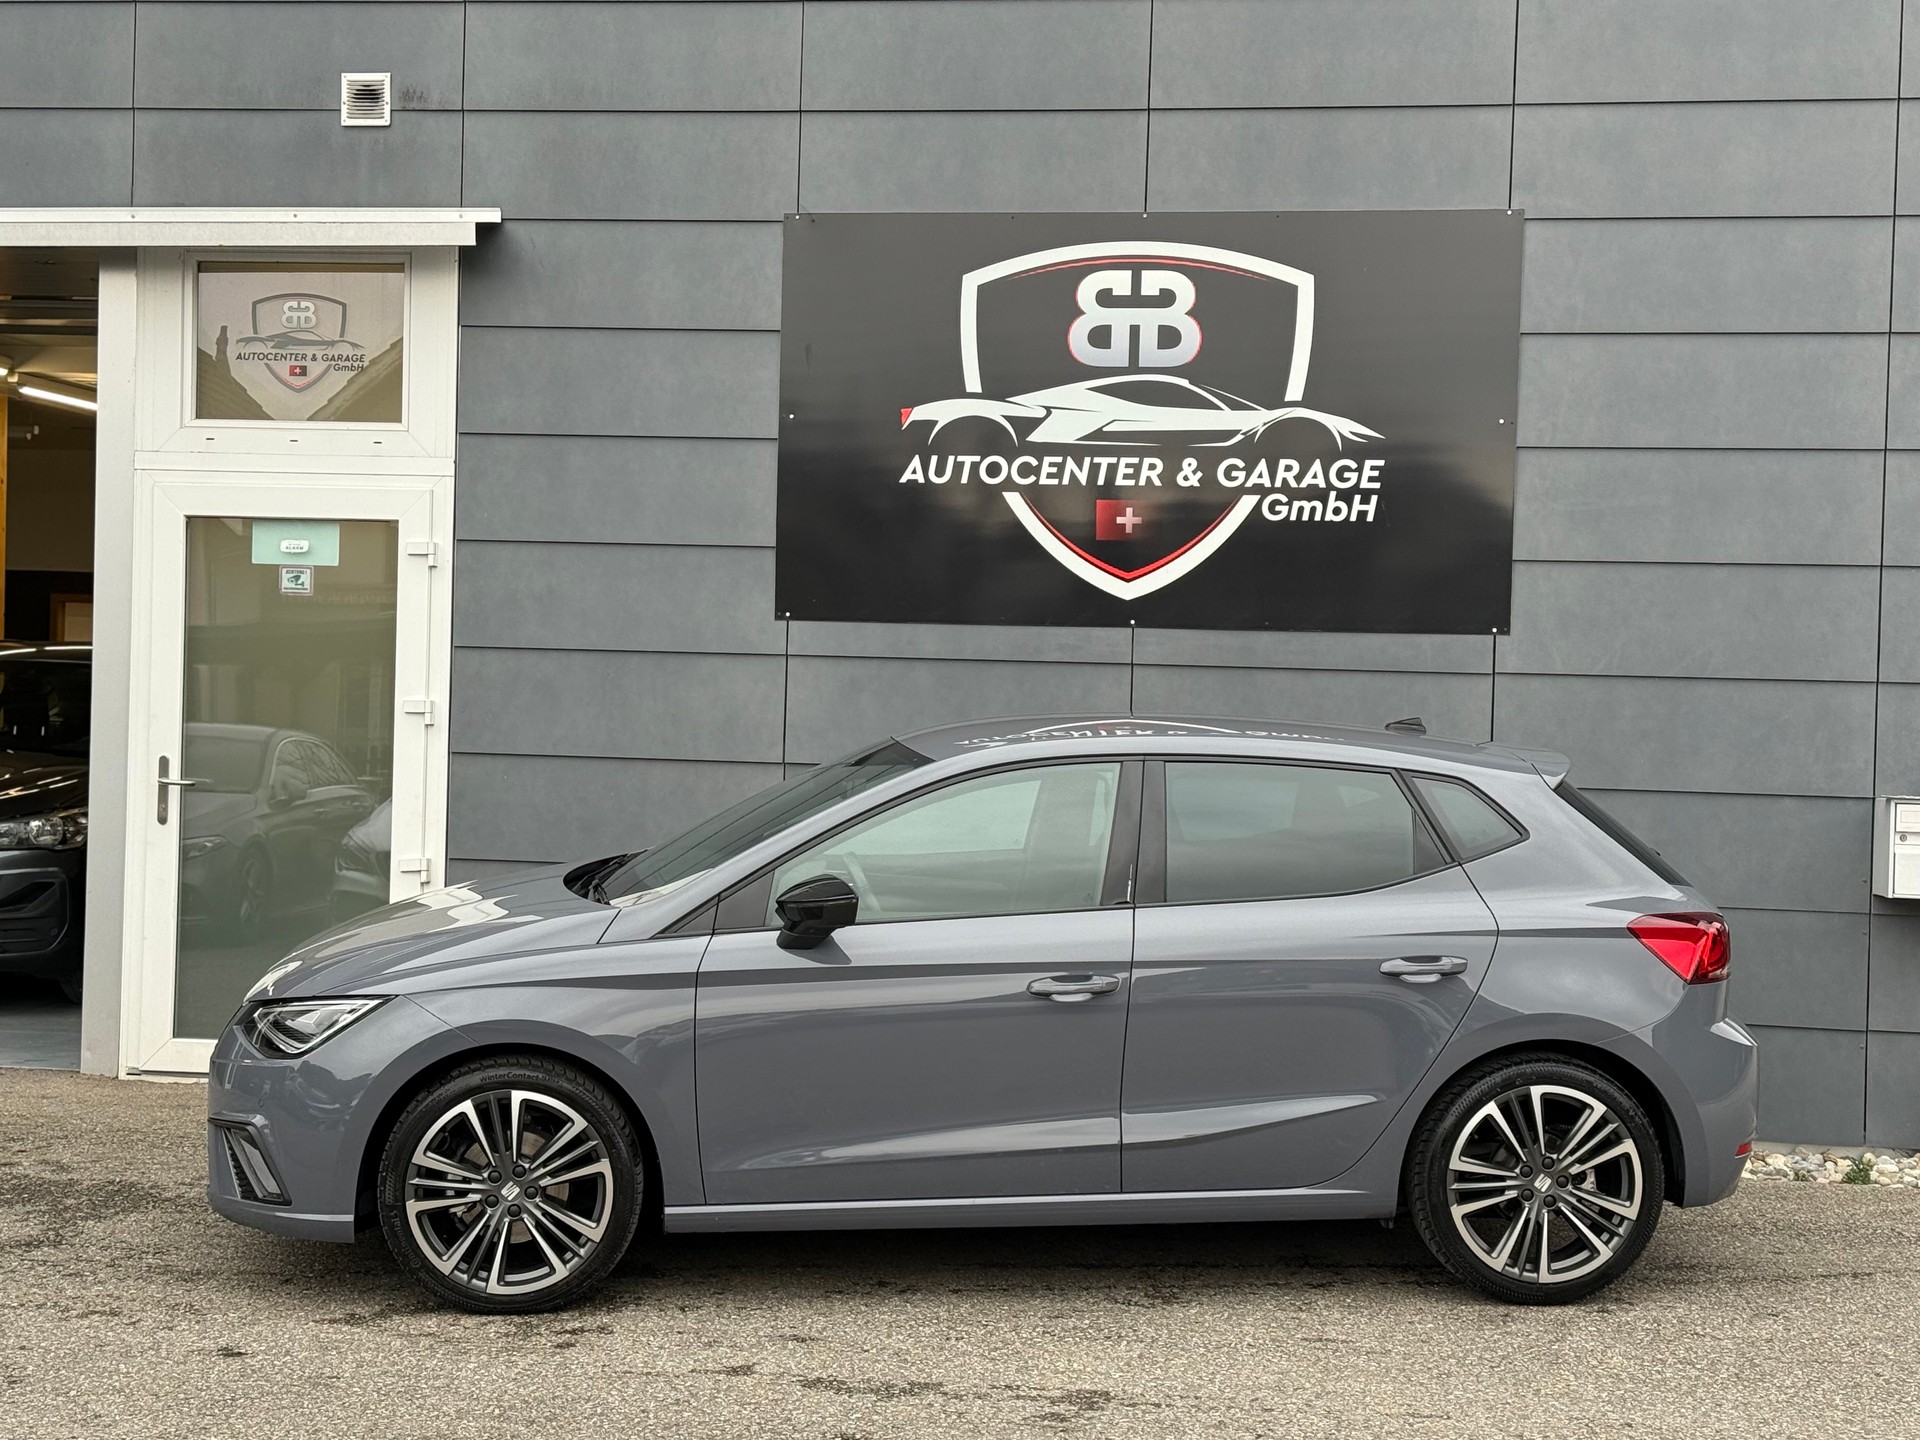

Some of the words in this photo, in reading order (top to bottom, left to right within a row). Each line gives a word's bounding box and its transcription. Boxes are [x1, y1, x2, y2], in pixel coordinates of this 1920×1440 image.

[235, 352, 308, 362] AUTOCENTER
[310, 354, 318, 362] &
[321, 353, 366, 363] GARAGE
[333, 363, 365, 372] GmbH
[899, 454, 1164, 486] AUTOCENTER
[1176, 457, 1203, 487] &
[1217, 458, 1386, 489] GARAGE
[1261, 491, 1379, 522] GmbH
